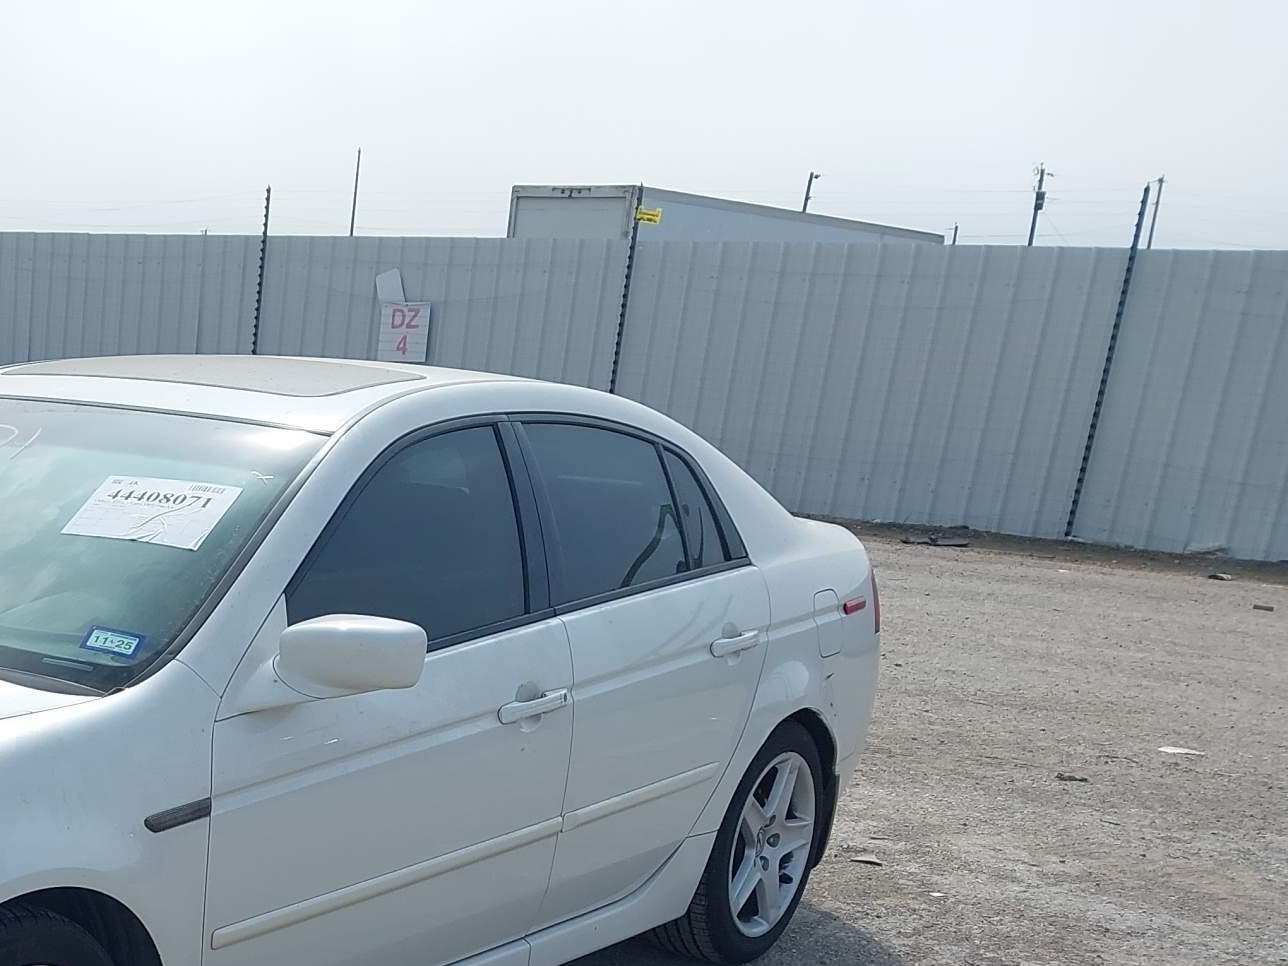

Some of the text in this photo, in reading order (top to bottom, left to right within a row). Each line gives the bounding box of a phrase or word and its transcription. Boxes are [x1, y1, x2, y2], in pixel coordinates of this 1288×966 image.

[391, 308, 421, 329] DZ
[395, 335, 409, 355] 4
[107, 489, 213, 509] 44408071
